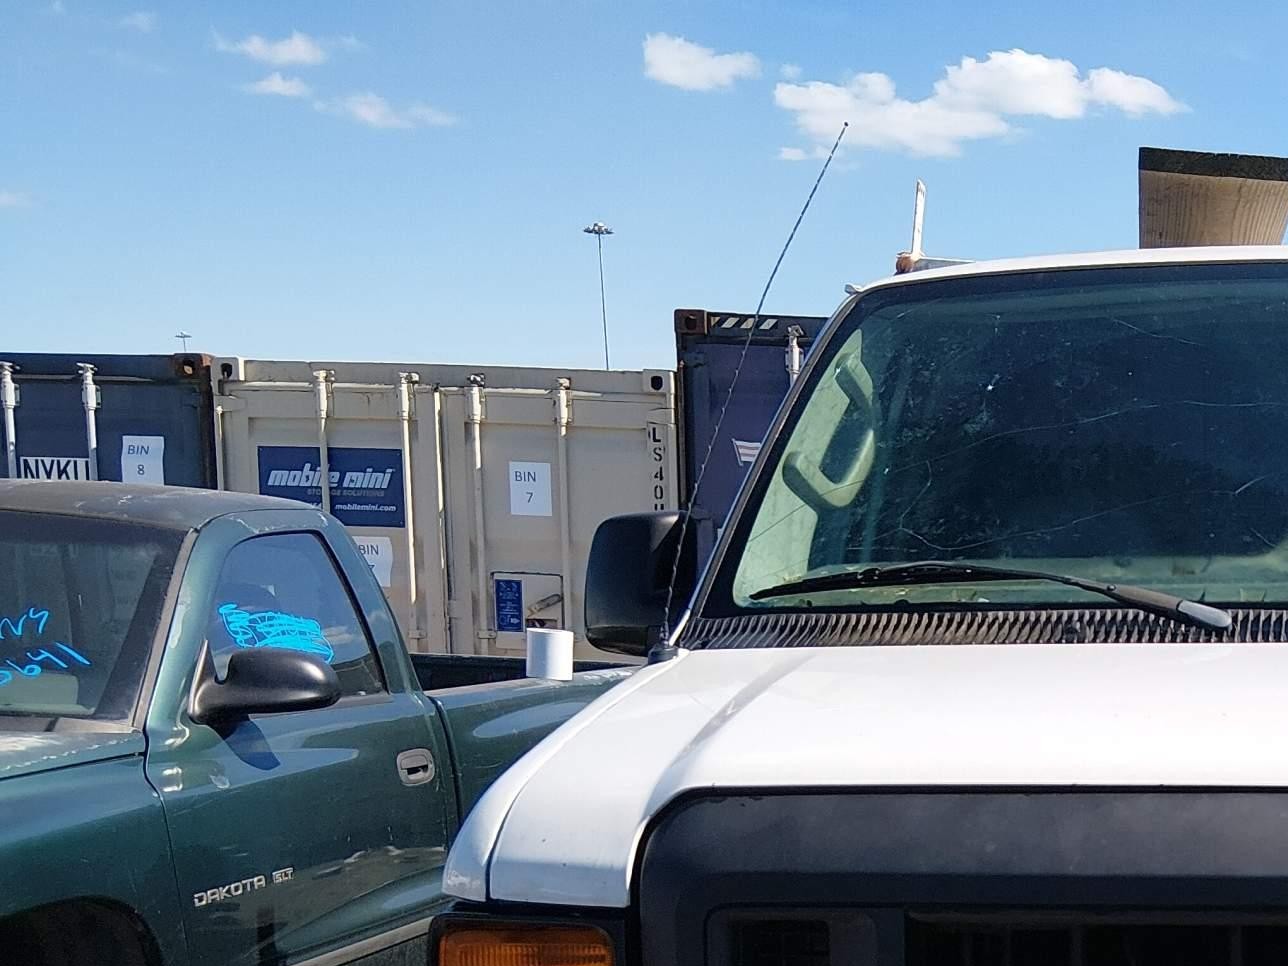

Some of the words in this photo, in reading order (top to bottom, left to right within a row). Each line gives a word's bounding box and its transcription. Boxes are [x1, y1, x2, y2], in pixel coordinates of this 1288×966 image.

[127, 444, 150, 456] BIN
[136, 464, 146, 476] 8
[514, 470, 537, 483] BIN
[342, 468, 394, 489] mini
[525, 491, 534, 504] 7
[335, 503, 397, 512] mobilemini.com
[193, 875, 266, 907] DAKOTA
[272, 867, 294, 884] SLT
